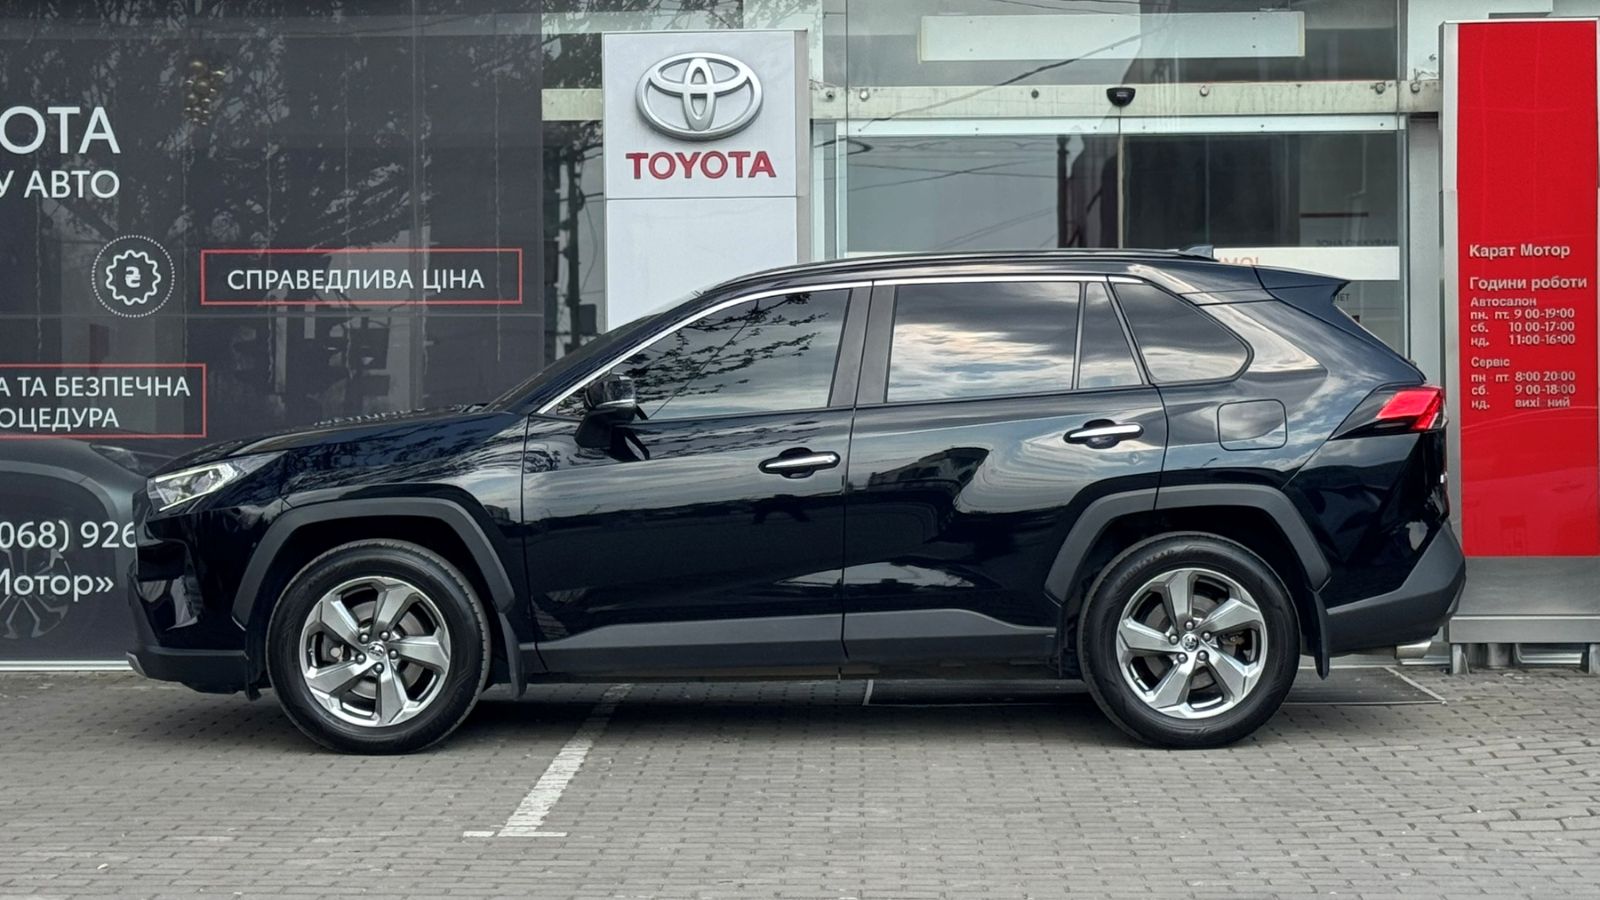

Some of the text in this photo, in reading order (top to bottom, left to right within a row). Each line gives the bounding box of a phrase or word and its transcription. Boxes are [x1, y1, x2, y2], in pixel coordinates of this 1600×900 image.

[625, 150, 777, 180] TOYOTA
[24, 169, 121, 199] АВТО
[1469, 243, 1570, 259] Карат Мотор
[227, 269, 485, 294] СПРАВЕДЛИВА ЦІНА
[1469, 275, 1587, 291] Години роботи
[1470, 297, 1537, 307] Автосалон
[1470, 311, 1489, 320] пн.
[1470, 322, 1489, 333] сб.
[1470, 334, 1576, 347] нд. 11:00-16:00
[1471, 356, 1510, 368] Сервіс
[17, 376, 48, 397] ТА
[54, 376, 191, 398] БЕЗПЕЧНА
[1471, 400, 1490, 410] нд.
